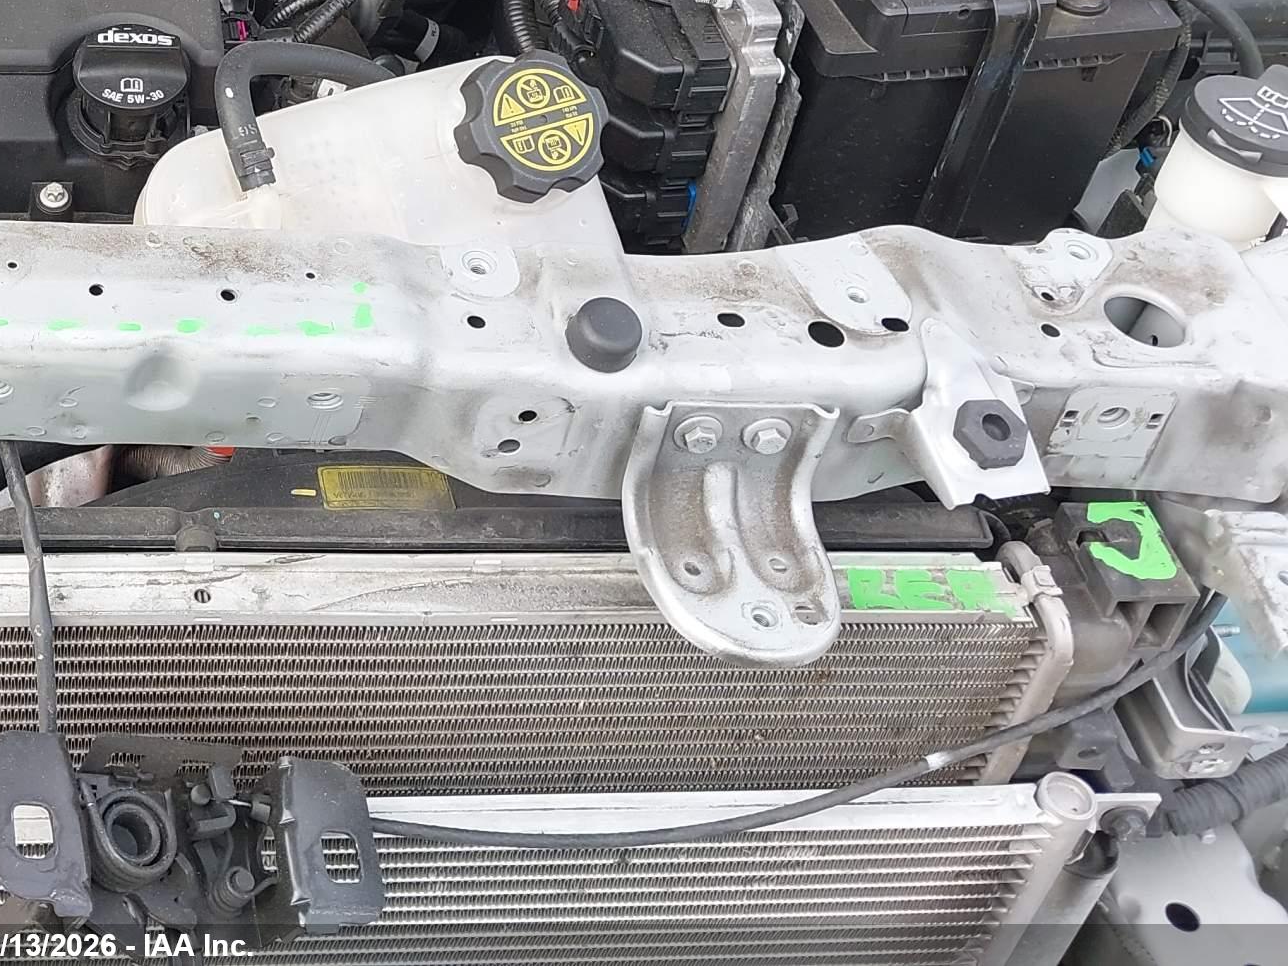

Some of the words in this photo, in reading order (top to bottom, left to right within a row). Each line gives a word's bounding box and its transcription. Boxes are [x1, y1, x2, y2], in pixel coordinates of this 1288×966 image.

[97, 29, 176, 46] dexos
[102, 88, 124, 103] SAE
[127, 89, 165, 104] 5W-30
